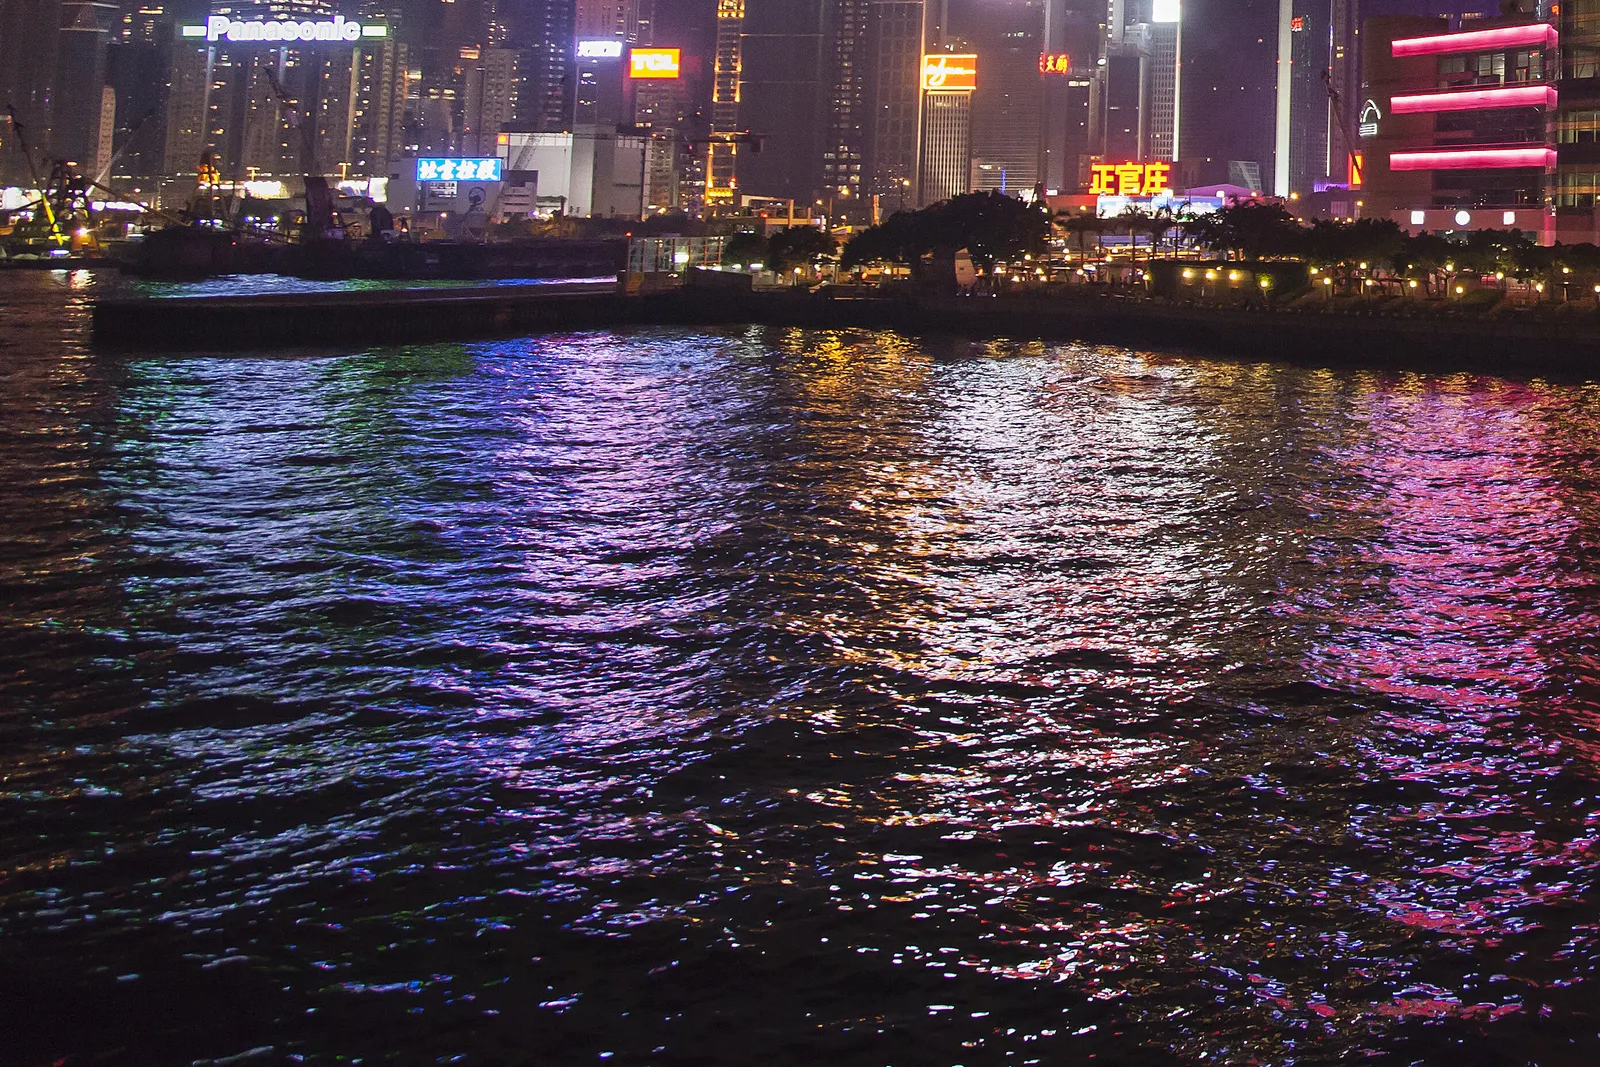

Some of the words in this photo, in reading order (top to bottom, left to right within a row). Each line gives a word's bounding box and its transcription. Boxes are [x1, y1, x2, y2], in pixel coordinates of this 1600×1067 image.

[207, 16, 361, 41] Panasonic
[631, 53, 678, 70] TCL
[1088, 161, 1170, 196] 正官庄
